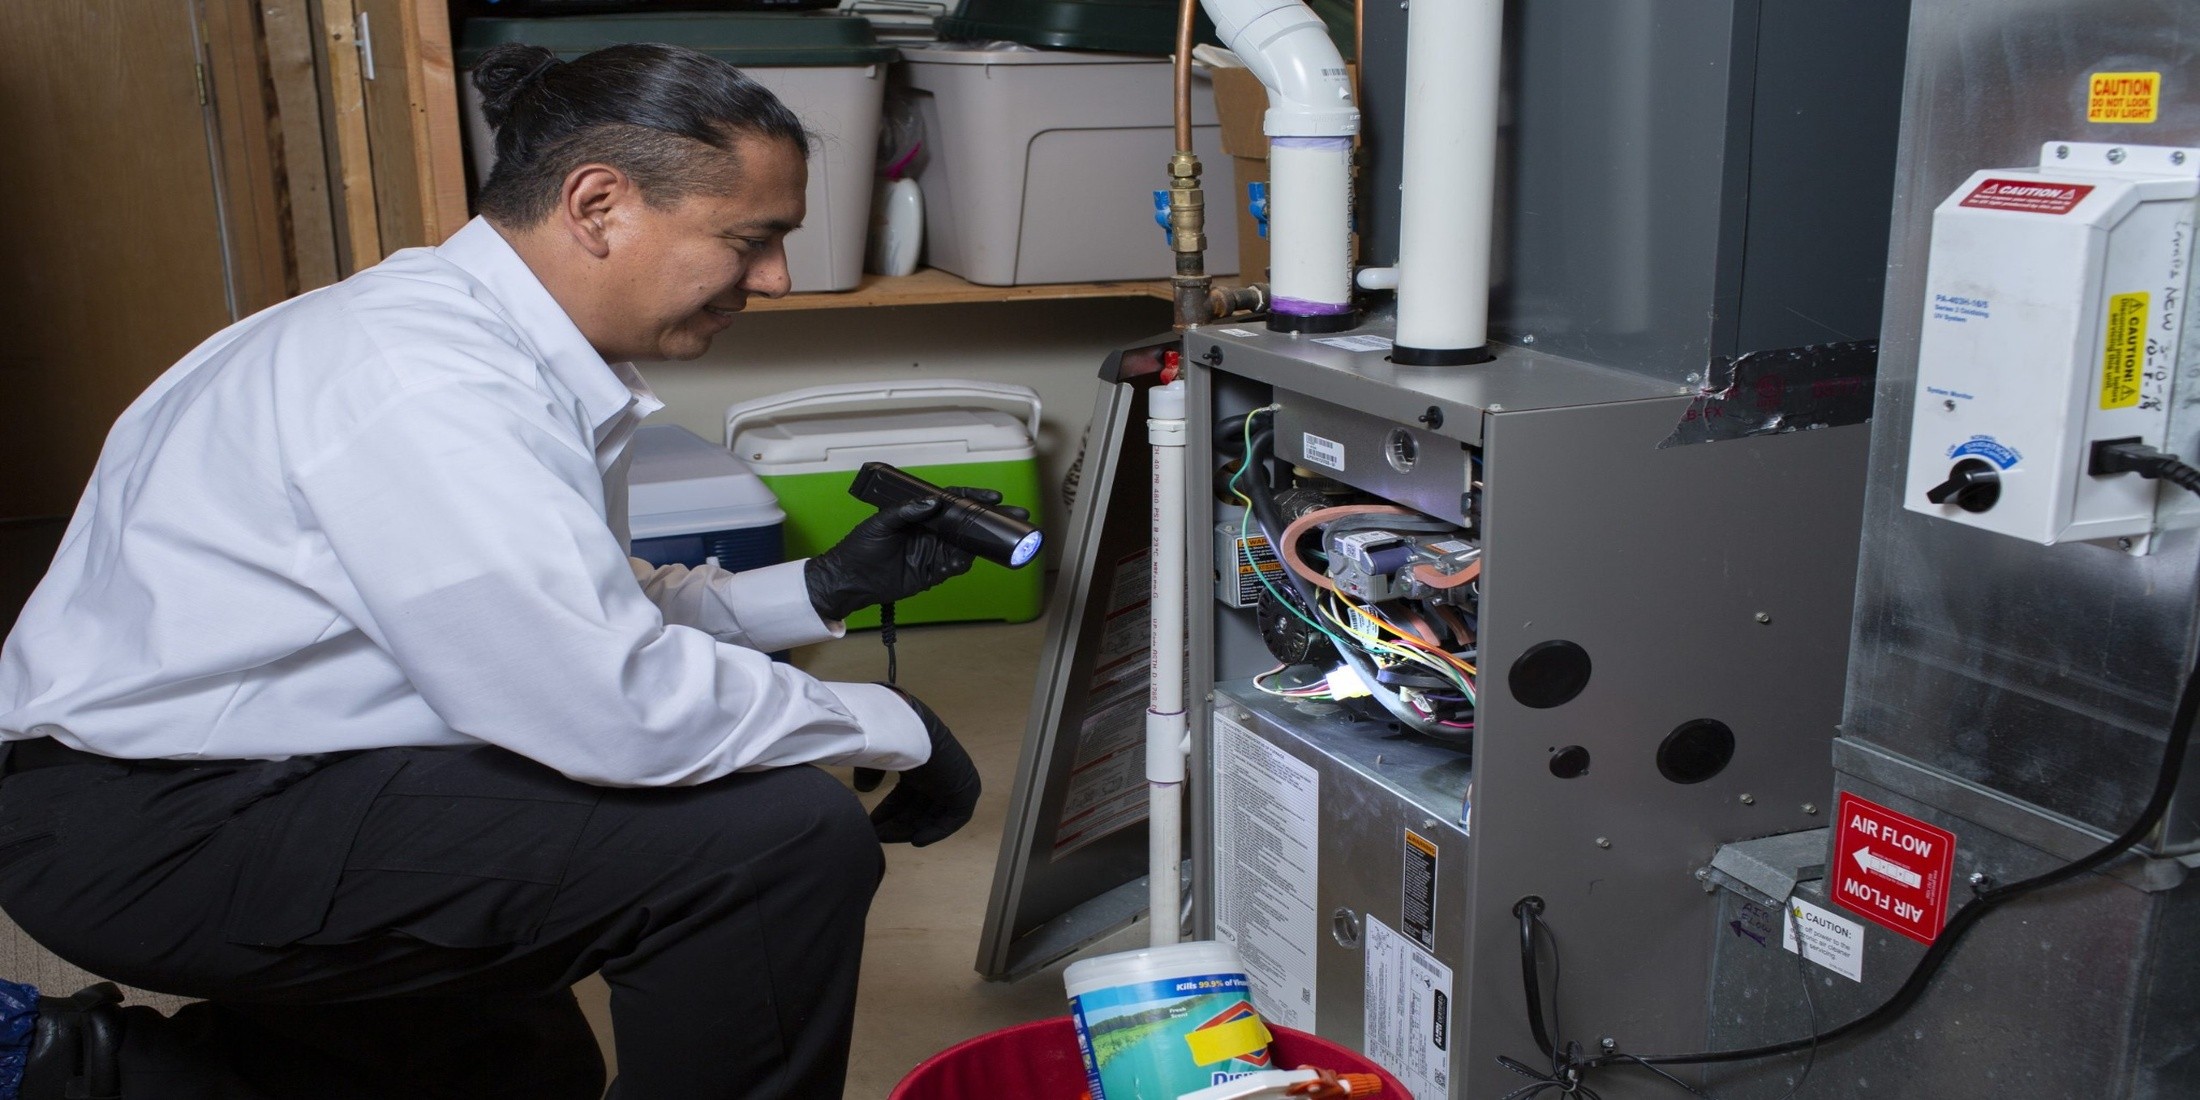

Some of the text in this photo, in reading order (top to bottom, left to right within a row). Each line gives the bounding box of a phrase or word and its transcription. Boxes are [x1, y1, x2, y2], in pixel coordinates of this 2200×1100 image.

[2094, 79, 2153, 96] CAUTION
[2106, 98, 2124, 107] NOT
[2127, 98, 2151, 107] LOOK
[2089, 108, 2151, 118] AT UV LIGHT
[1998, 185, 2063, 198] CAUTION
[2123, 316, 2141, 383] CAUTION!
[1850, 814, 1932, 858] AIR FLOW
[1844, 877, 1891, 911] FLOW
[1893, 898, 1924, 924] AIR
[1805, 912, 1852, 939] CAUTION:
[1814, 930, 1832, 943] power
[1175, 981, 1198, 992] Kills
[1198, 980, 1224, 989] 99.9%
[1224, 978, 1232, 987] of
